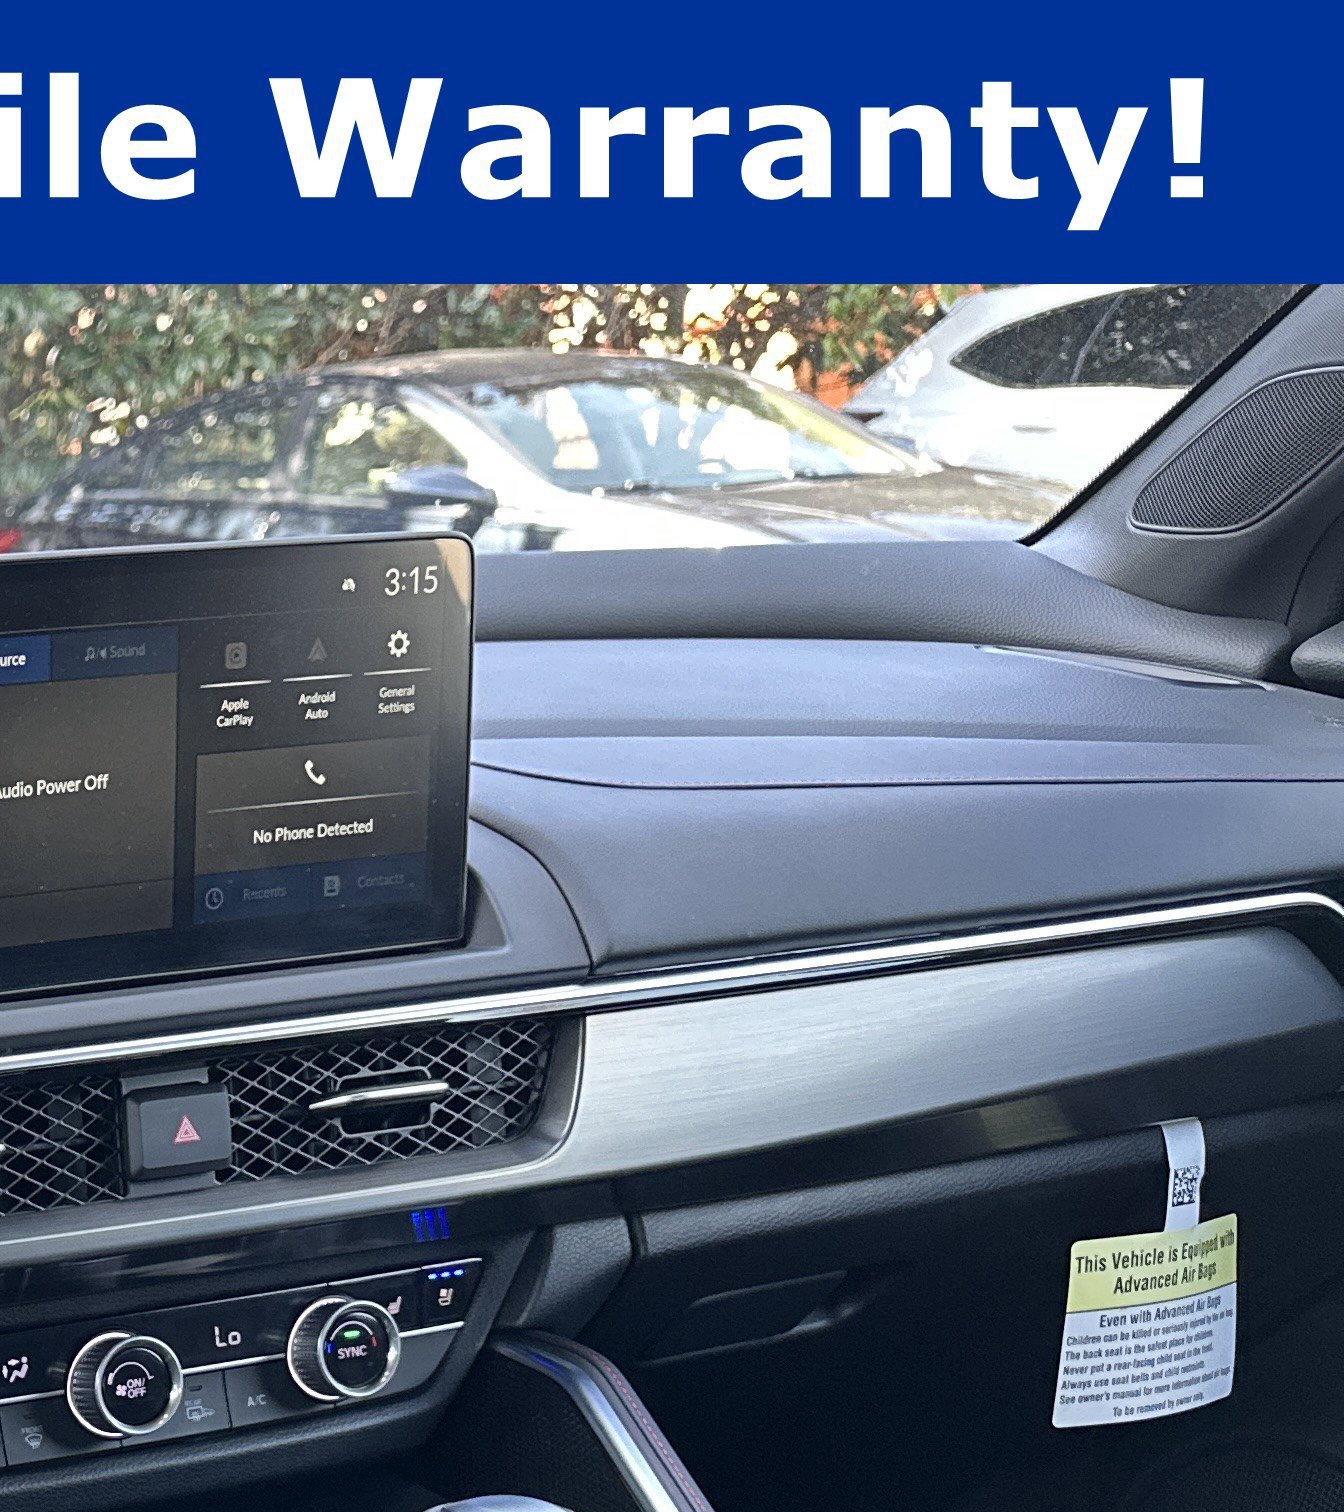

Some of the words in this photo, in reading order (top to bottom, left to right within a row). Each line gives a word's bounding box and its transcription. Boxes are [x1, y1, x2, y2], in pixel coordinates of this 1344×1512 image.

[384, 565, 438, 596] 3:15
[109, 642, 146, 659] Sound
[298, 691, 336, 705] Android
[379, 684, 415, 698] General
[221, 698, 249, 713] Apple
[305, 708, 328, 720] Auto
[378, 701, 415, 714] Settings
[216, 713, 254, 727] CarPlay
[37, 777, 82, 796] Power
[85, 774, 109, 790] Off
[253, 830, 272, 844] No
[275, 826, 314, 842] Phone
[317, 819, 374, 838] Detected
[357, 872, 406, 888] Contacts
[1075, 1254, 1107, 1274] This
[1112, 1248, 1165, 1270] Vehicle
[1168, 1245, 1178, 1263] is
[1181, 1234, 1219, 1260] Equipped
[1220, 1229, 1235, 1248] with
[1113, 1268, 1179, 1294] Advanced
[1181, 1265, 1196, 1284] Air
[1197, 1260, 1217, 1281] Bags
[1099, 1314, 1127, 1328] Even
[1130, 1310, 1152, 1324] with
[1154, 1301, 1195, 1320] Advanced
[1196, 1298, 1207, 1312] Air
[214, 1326, 242, 1347] Lo
[1066, 1334, 1101, 1346] Children
[1103, 1333, 1118, 1342] can
[1120, 1331, 1130, 1341] be
[1132, 1327, 1152, 1339] killed
[337, 1344, 367, 1360] SYNC
[1065, 1351, 1080, 1361] The
[1083, 1348, 1102, 1359] back
[1104, 1346, 1122, 1357] seat
[1125, 1345, 1132, 1355] is
[1134, 1344, 1145, 1353] the
[1063, 1365, 1088, 1375] Never
[1090, 1363, 1104, 1375] put
[1106, 1363, 1112, 1372] a
[1114, 1357, 1155, 1371] rear-facing
[126, 1377, 146, 1389] ON/
[1061, 1379, 1092, 1390] Always
[1094, 1378, 1109, 1387] use
[1111, 1375, 1129, 1386] seat
[1131, 1372, 1149, 1383] belts
[127, 1387, 147, 1399] OFF
[247, 1393, 267, 1407] A/C
[1059, 1394, 1076, 1405] See
[1078, 1391, 1110, 1403] owner's
[1113, 1387, 1141, 1399] manual
[1113, 1406, 1122, 1417] To
[1124, 1405, 1135, 1416] be
